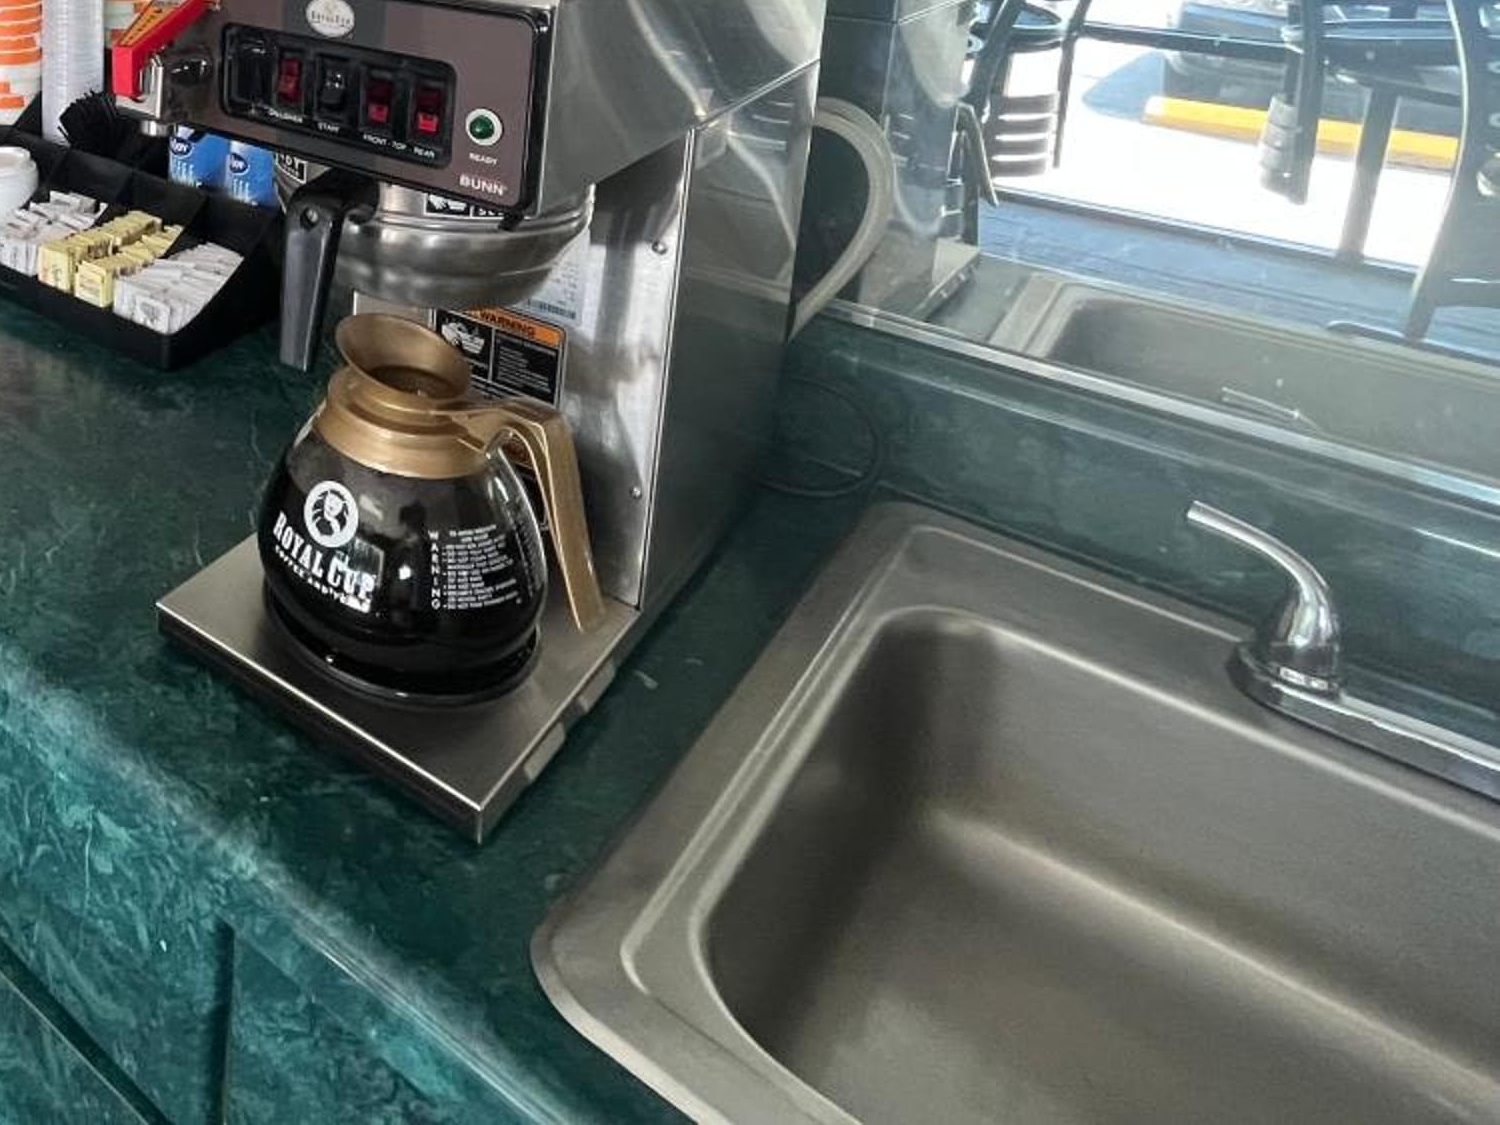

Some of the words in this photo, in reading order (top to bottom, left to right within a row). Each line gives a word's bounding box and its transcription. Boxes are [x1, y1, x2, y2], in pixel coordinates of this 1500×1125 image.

[363, 134, 387, 146] FRONT
[413, 146, 435, 159] REAR
[468, 152, 498, 166] READY
[459, 174, 504, 196] BUNN
[481, 313, 535, 336] WARNING
[273, 510, 326, 579] ROYAL
[326, 555, 376, 601] CUP
[426, 529, 441, 611] WARNING
